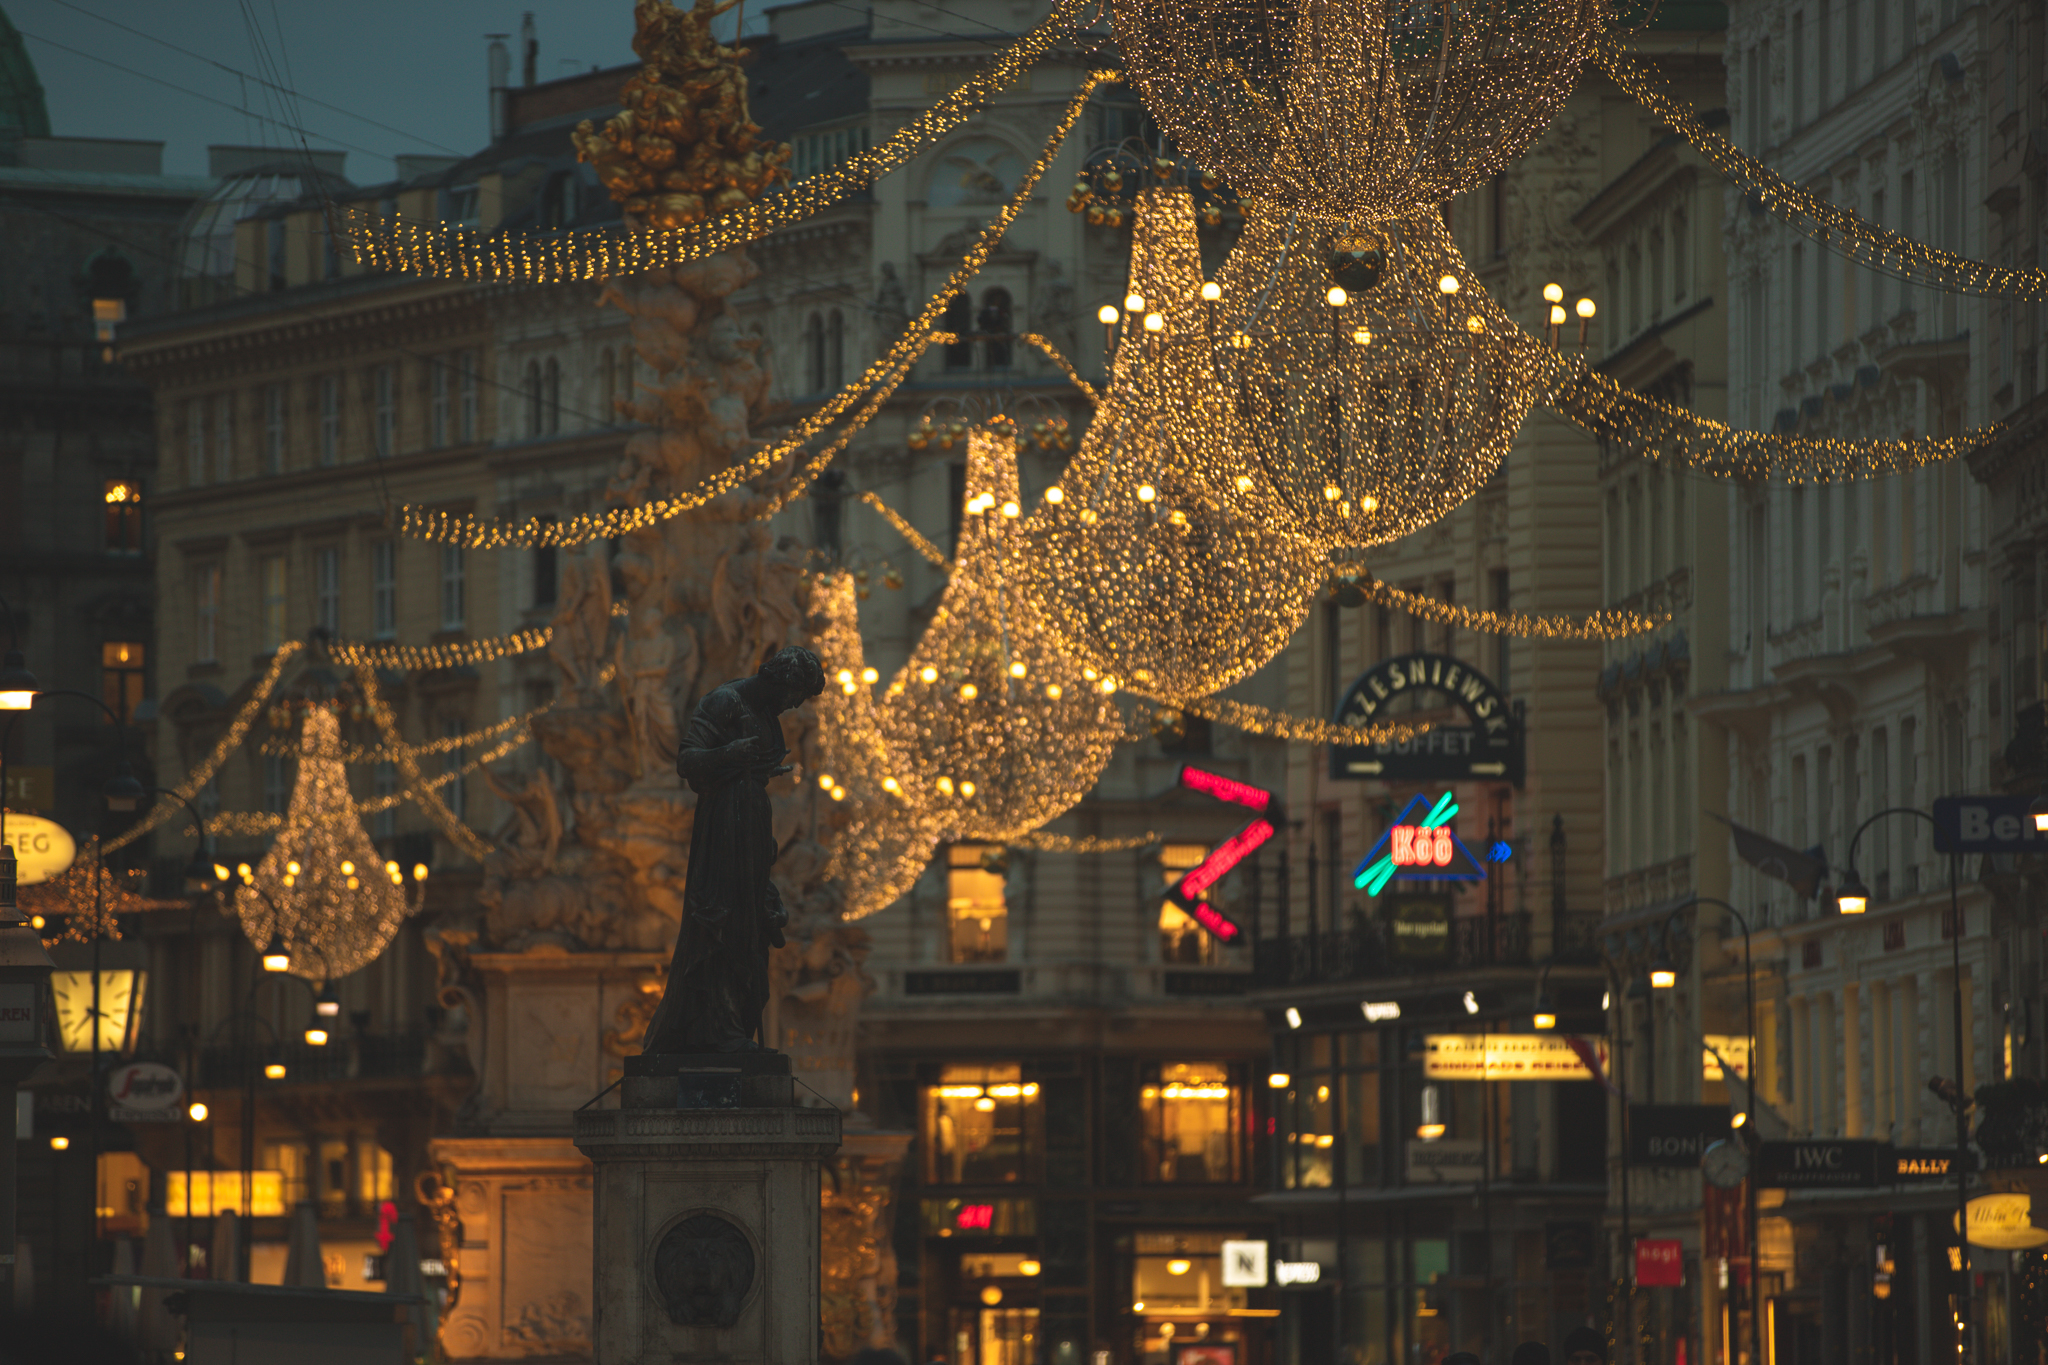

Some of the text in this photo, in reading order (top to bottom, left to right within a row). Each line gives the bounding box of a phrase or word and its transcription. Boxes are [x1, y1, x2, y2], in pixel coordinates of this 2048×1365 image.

[1344, 657, 1508, 747] RZESNIEWSKI
[1375, 730, 1475, 756] BUFFET
[0, 1007, 31, 1022] REN
[1794, 1146, 1843, 1169] IWC
[1896, 1158, 1951, 1175] BALLY
[1237, 1251, 1256, 1274] N
